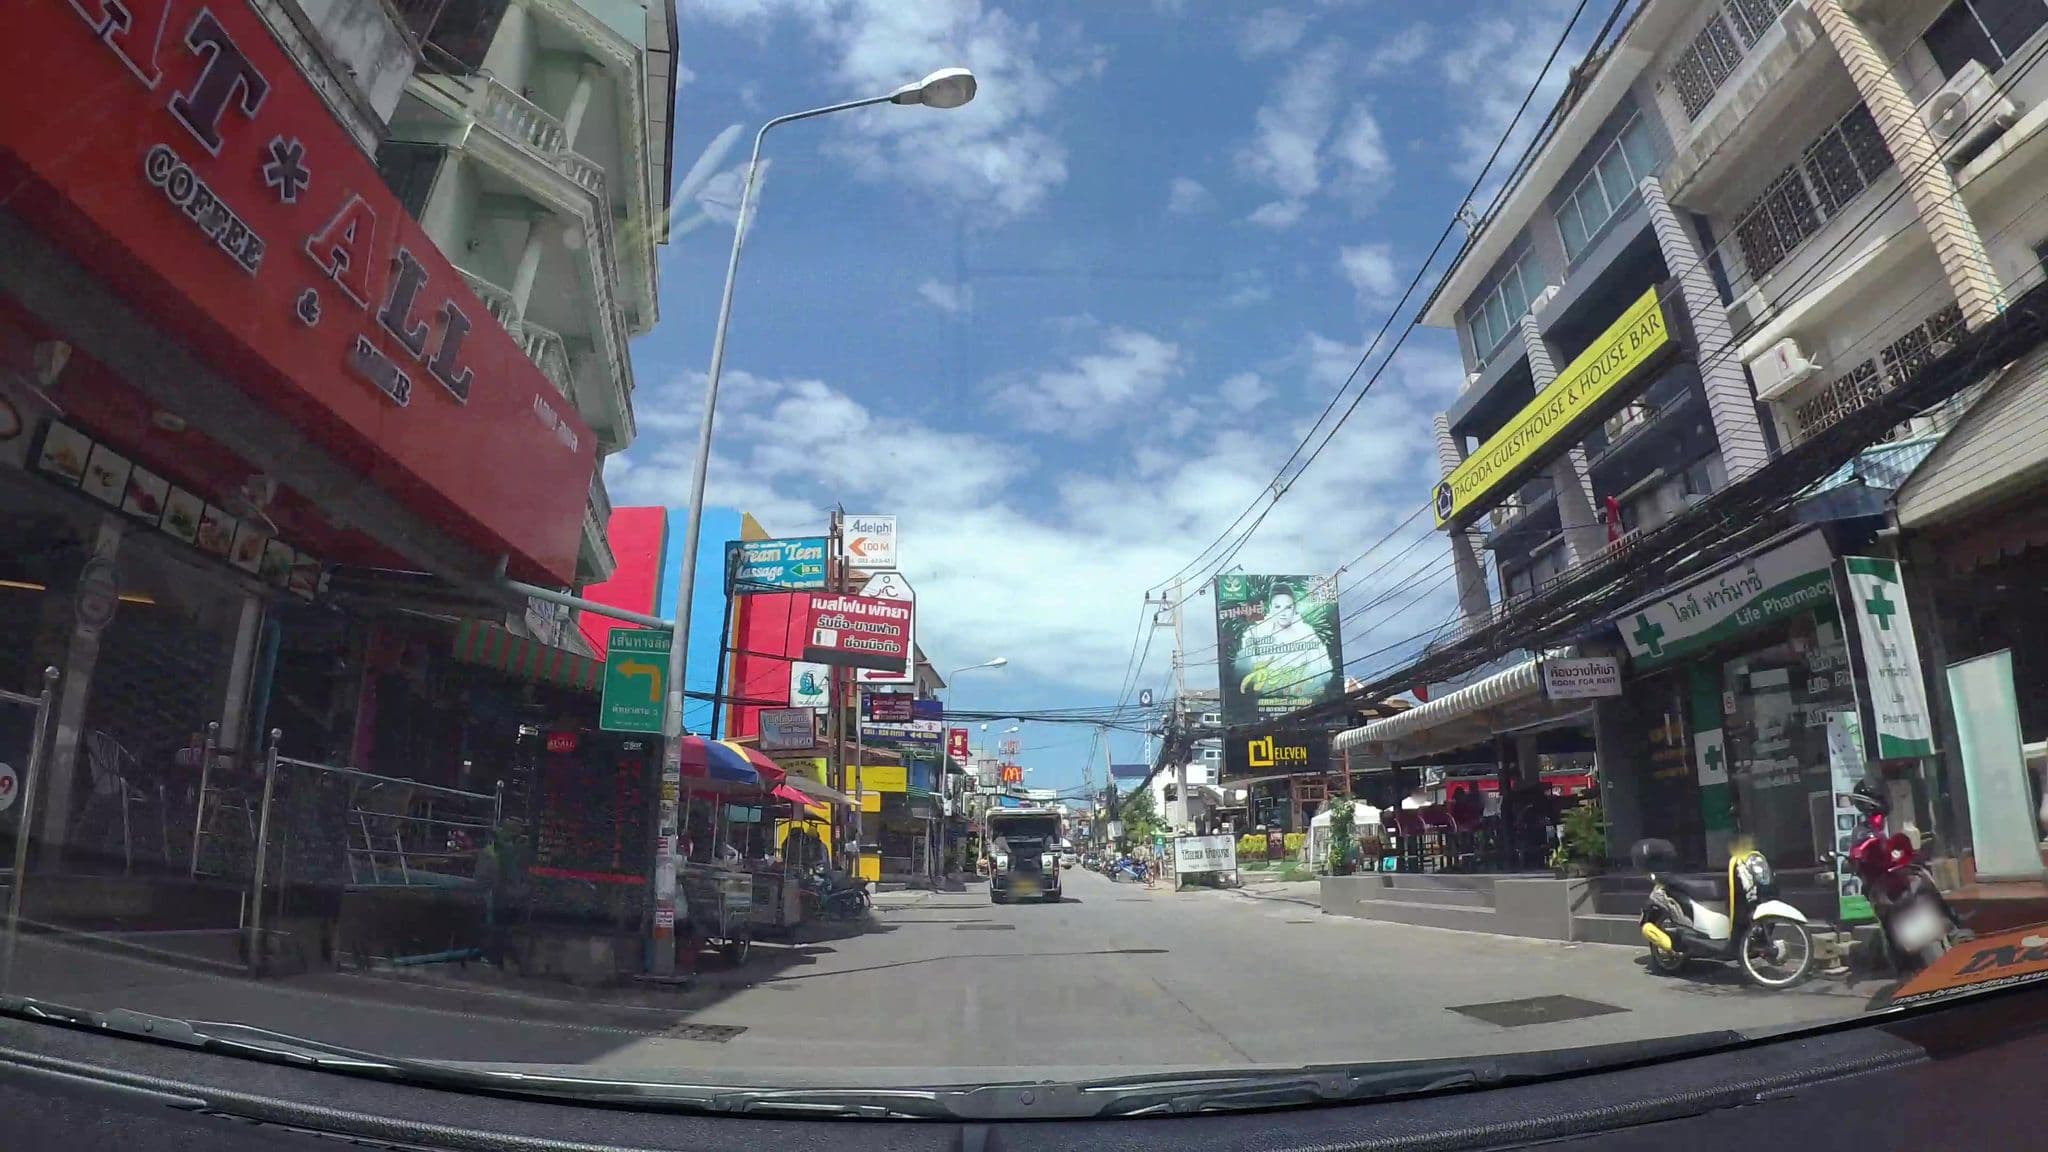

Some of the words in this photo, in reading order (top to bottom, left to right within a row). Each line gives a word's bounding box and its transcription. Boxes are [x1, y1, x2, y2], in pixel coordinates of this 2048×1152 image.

[145, 143, 266, 278] COFFEE
[297, 286, 321, 328] &
[305, 193, 476, 406] ALL
[1453, 460, 1494, 503] PAGODA
[1493, 396, 1566, 469] GUESTHOUSE
[1566, 388, 1579, 406] &
[1579, 342, 1629, 396] HOUSE
[1630, 312, 1661, 351] BAR
[849, 519, 893, 536] Adelphi
[785, 542, 823, 562] Teen
[863, 542, 879, 552] 100
[811, 596, 866, 615] เบสโฟน
[868, 600, 910, 621] พัทยา
[1667, 593, 1702, 623] ไลฟ์
[1702, 566, 1764, 612] ฟาร์มาซี
[1735, 607, 1763, 627] Life
[1762, 579, 1835, 617] Pharmacy
[1578, 678, 1594, 686] FOR
[1597, 677, 1616, 685] RENT
[1274, 746, 1307, 761] ELEVEN
